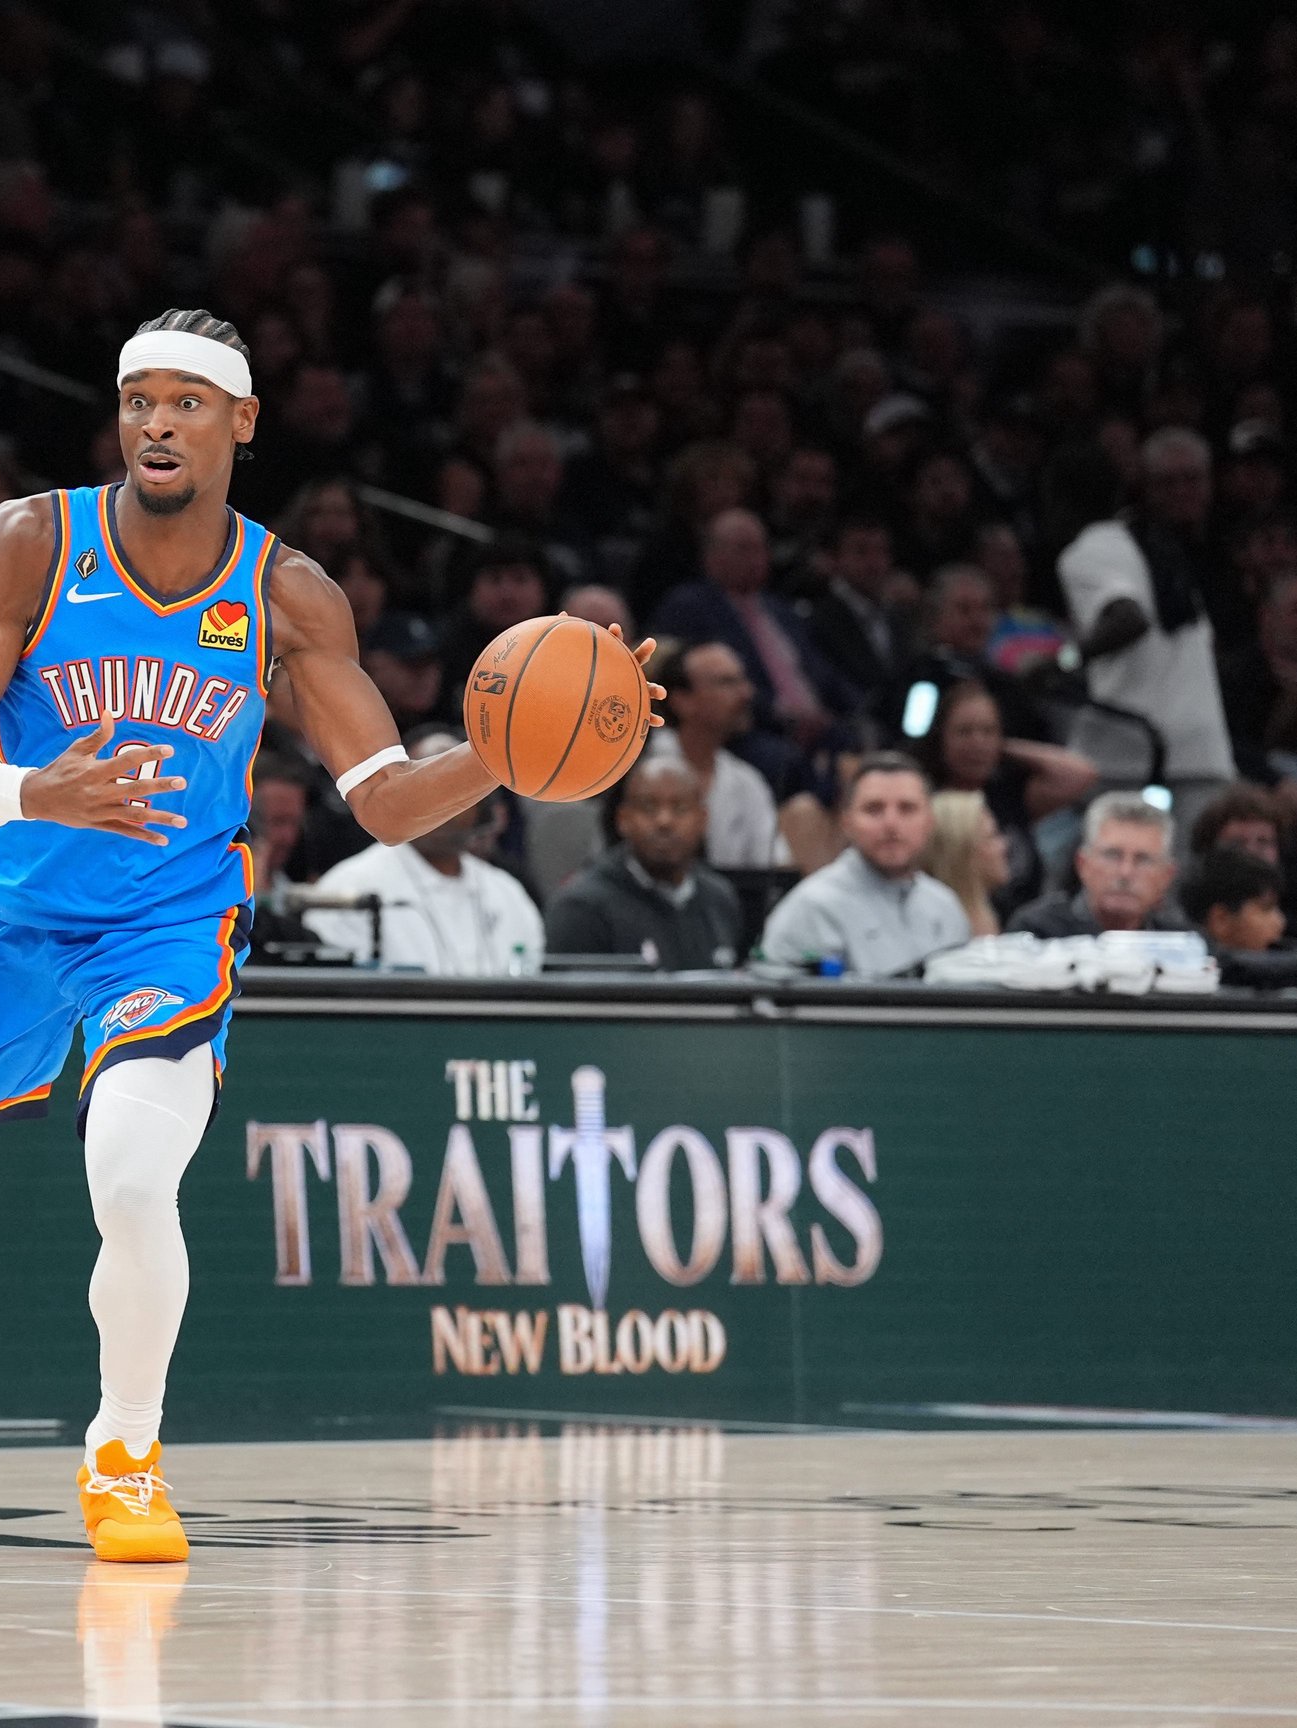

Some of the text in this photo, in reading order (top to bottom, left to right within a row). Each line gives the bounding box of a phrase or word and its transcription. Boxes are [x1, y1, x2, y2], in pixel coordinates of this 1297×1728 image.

[39, 656, 250, 742] THUNDER
[444, 1058, 541, 1122] THE
[245, 1118, 885, 1288] TRAITORS
[430, 1302, 728, 1377] NEW BLOOD
